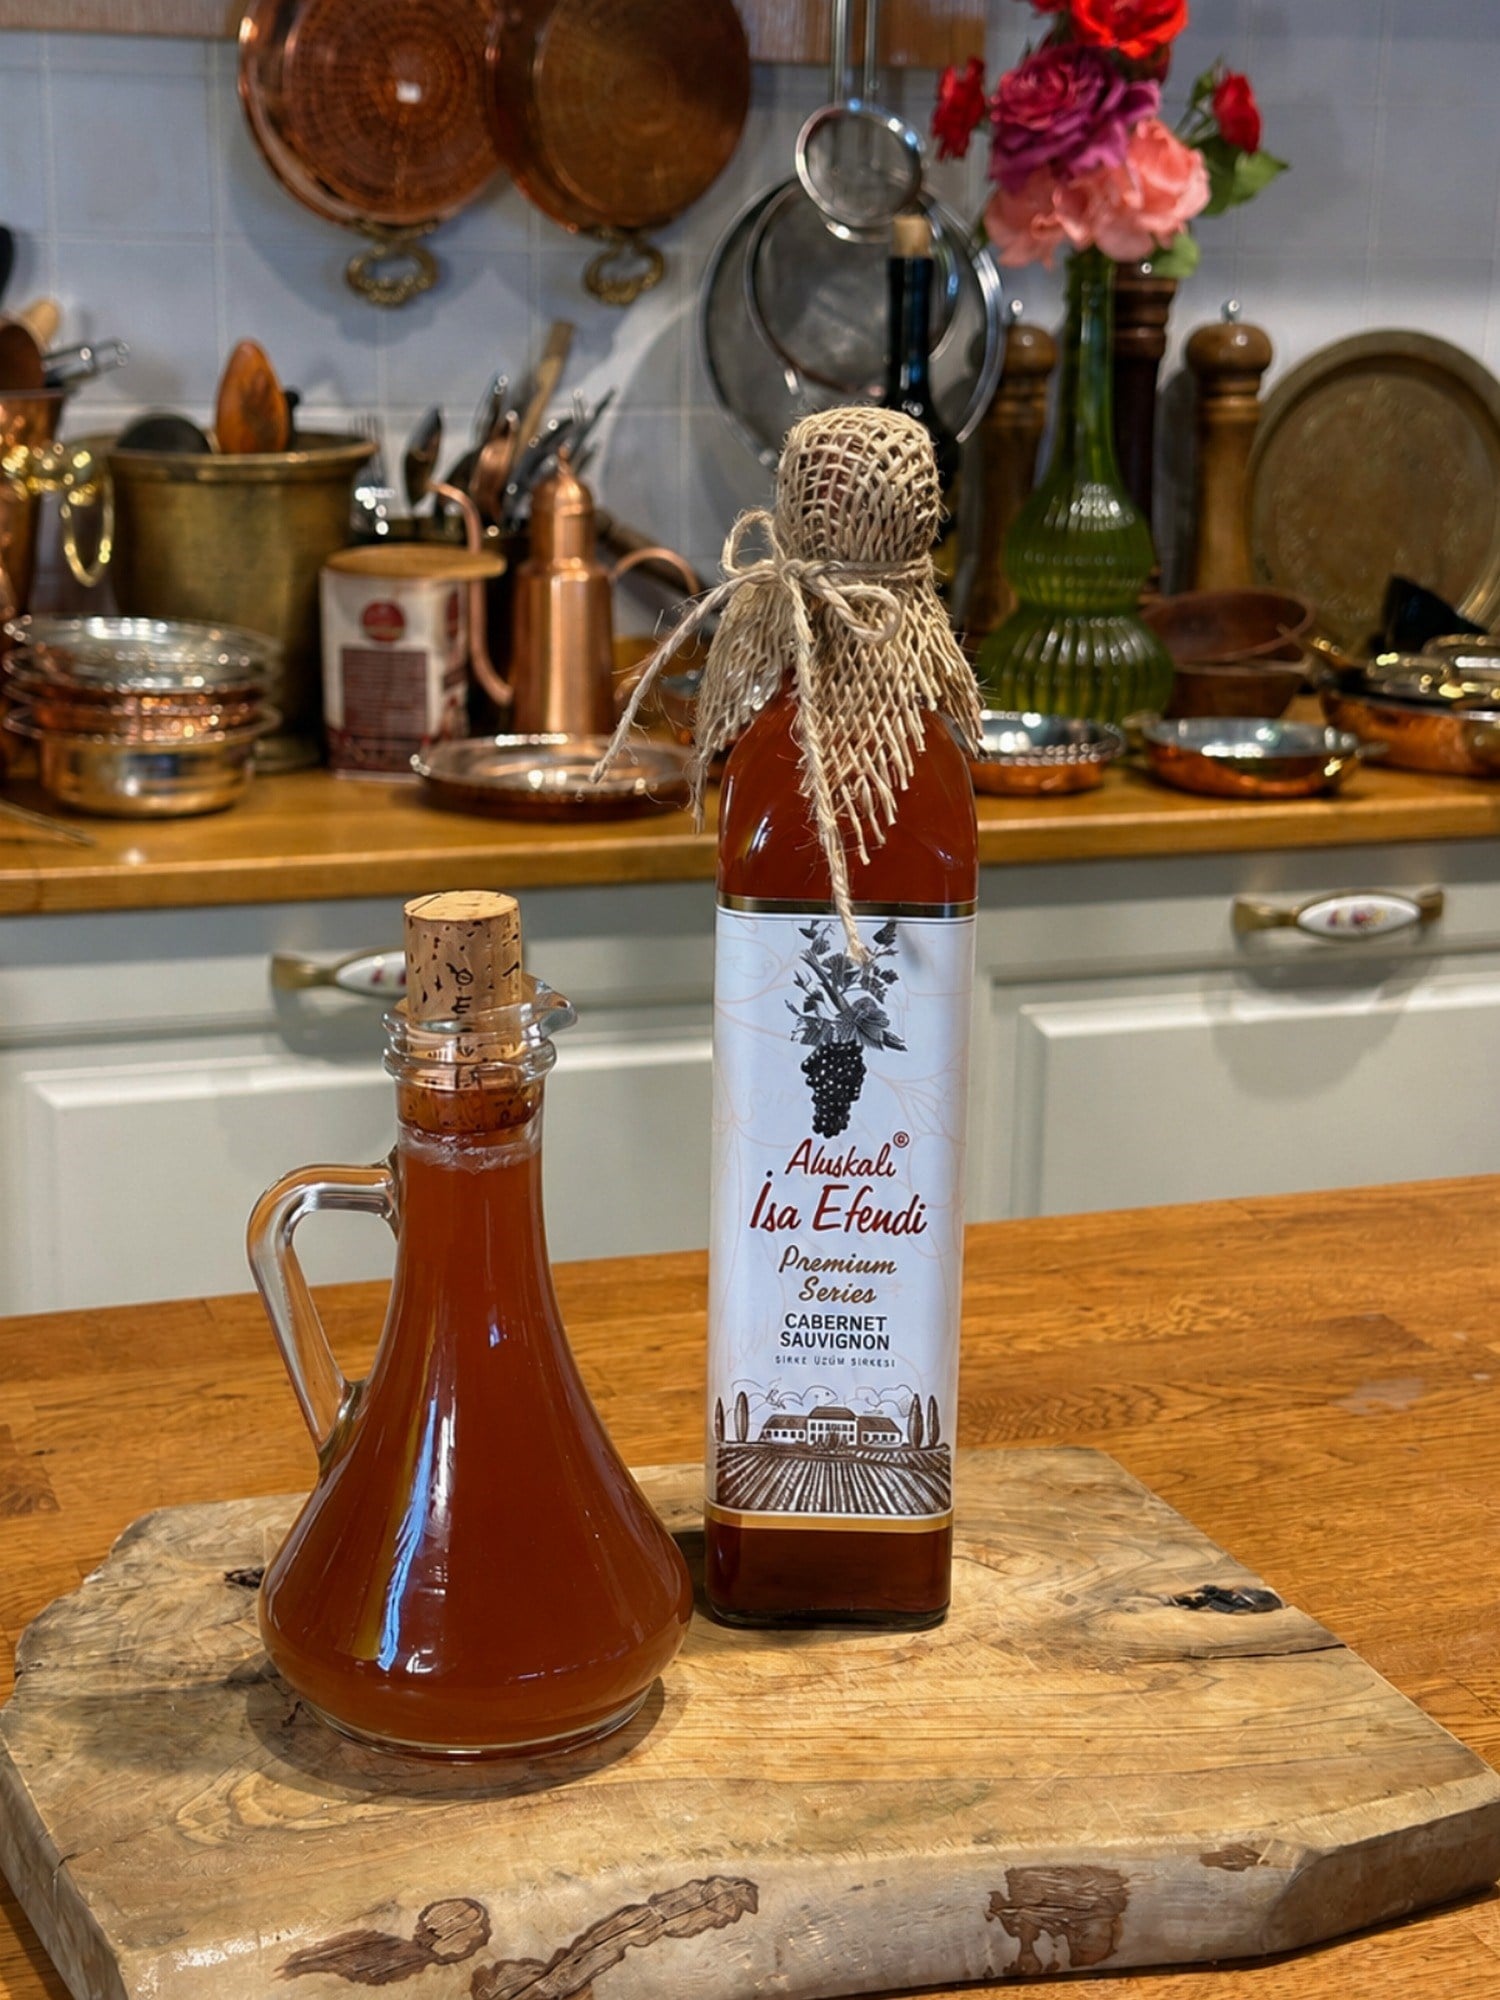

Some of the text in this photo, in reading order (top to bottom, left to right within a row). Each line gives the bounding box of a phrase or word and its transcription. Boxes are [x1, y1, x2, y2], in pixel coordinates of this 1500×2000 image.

[749, 1170, 928, 1236] İsa Efendi
[778, 1244, 898, 1275] Premium
[798, 1275, 877, 1304] Series
[784, 1312, 888, 1332] CABERNET
[779, 1330, 890, 1351] SAUVIGNON
